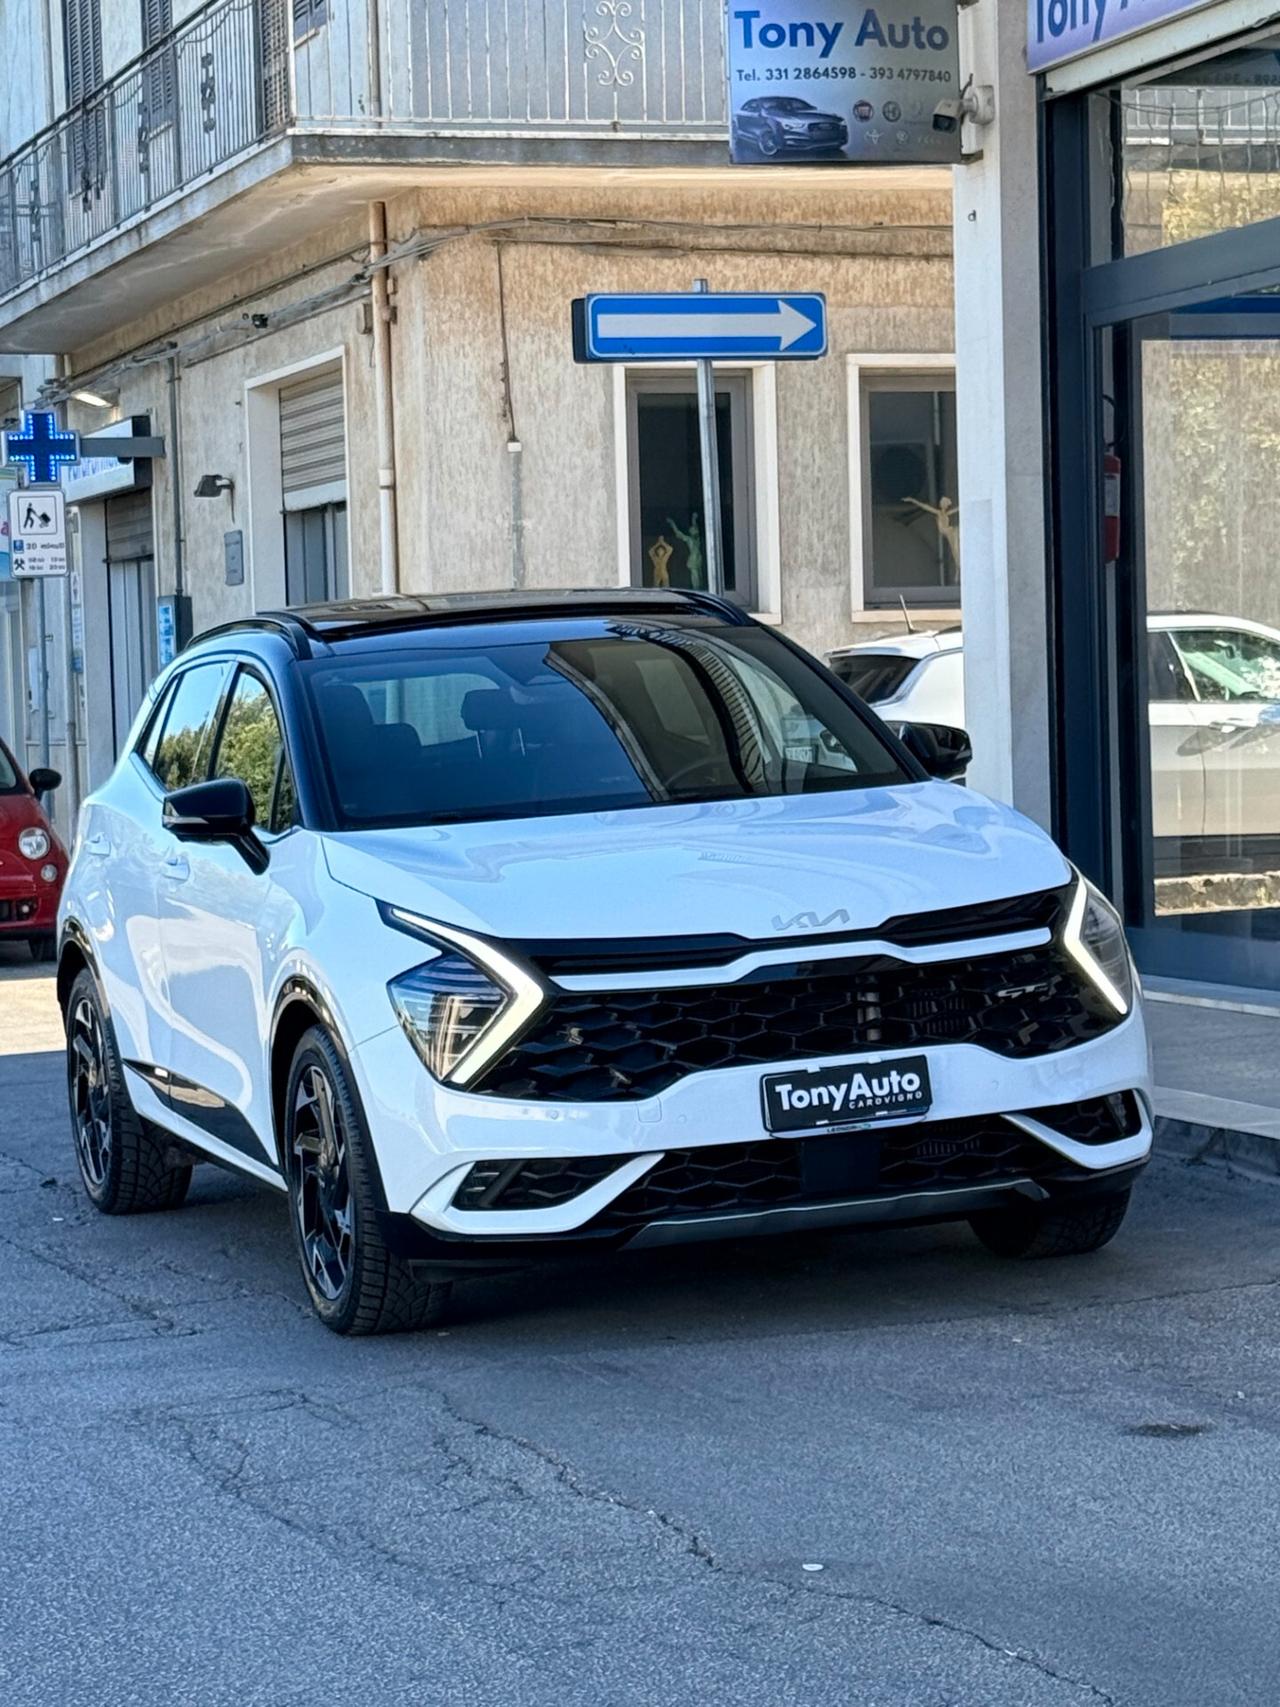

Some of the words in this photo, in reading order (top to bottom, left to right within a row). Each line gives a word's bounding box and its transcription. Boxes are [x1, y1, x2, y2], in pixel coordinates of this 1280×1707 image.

[734, 10, 844, 58] Tony
[855, 8, 950, 51] Auto
[736, 68, 761, 82] Tel.
[765, 67, 788, 81] 331
[794, 66, 857, 80] 2864598
[870, 67, 894, 80] 393
[897, 68, 952, 83] 4797840
[848, 1090, 924, 1110] CAROVIGNO
